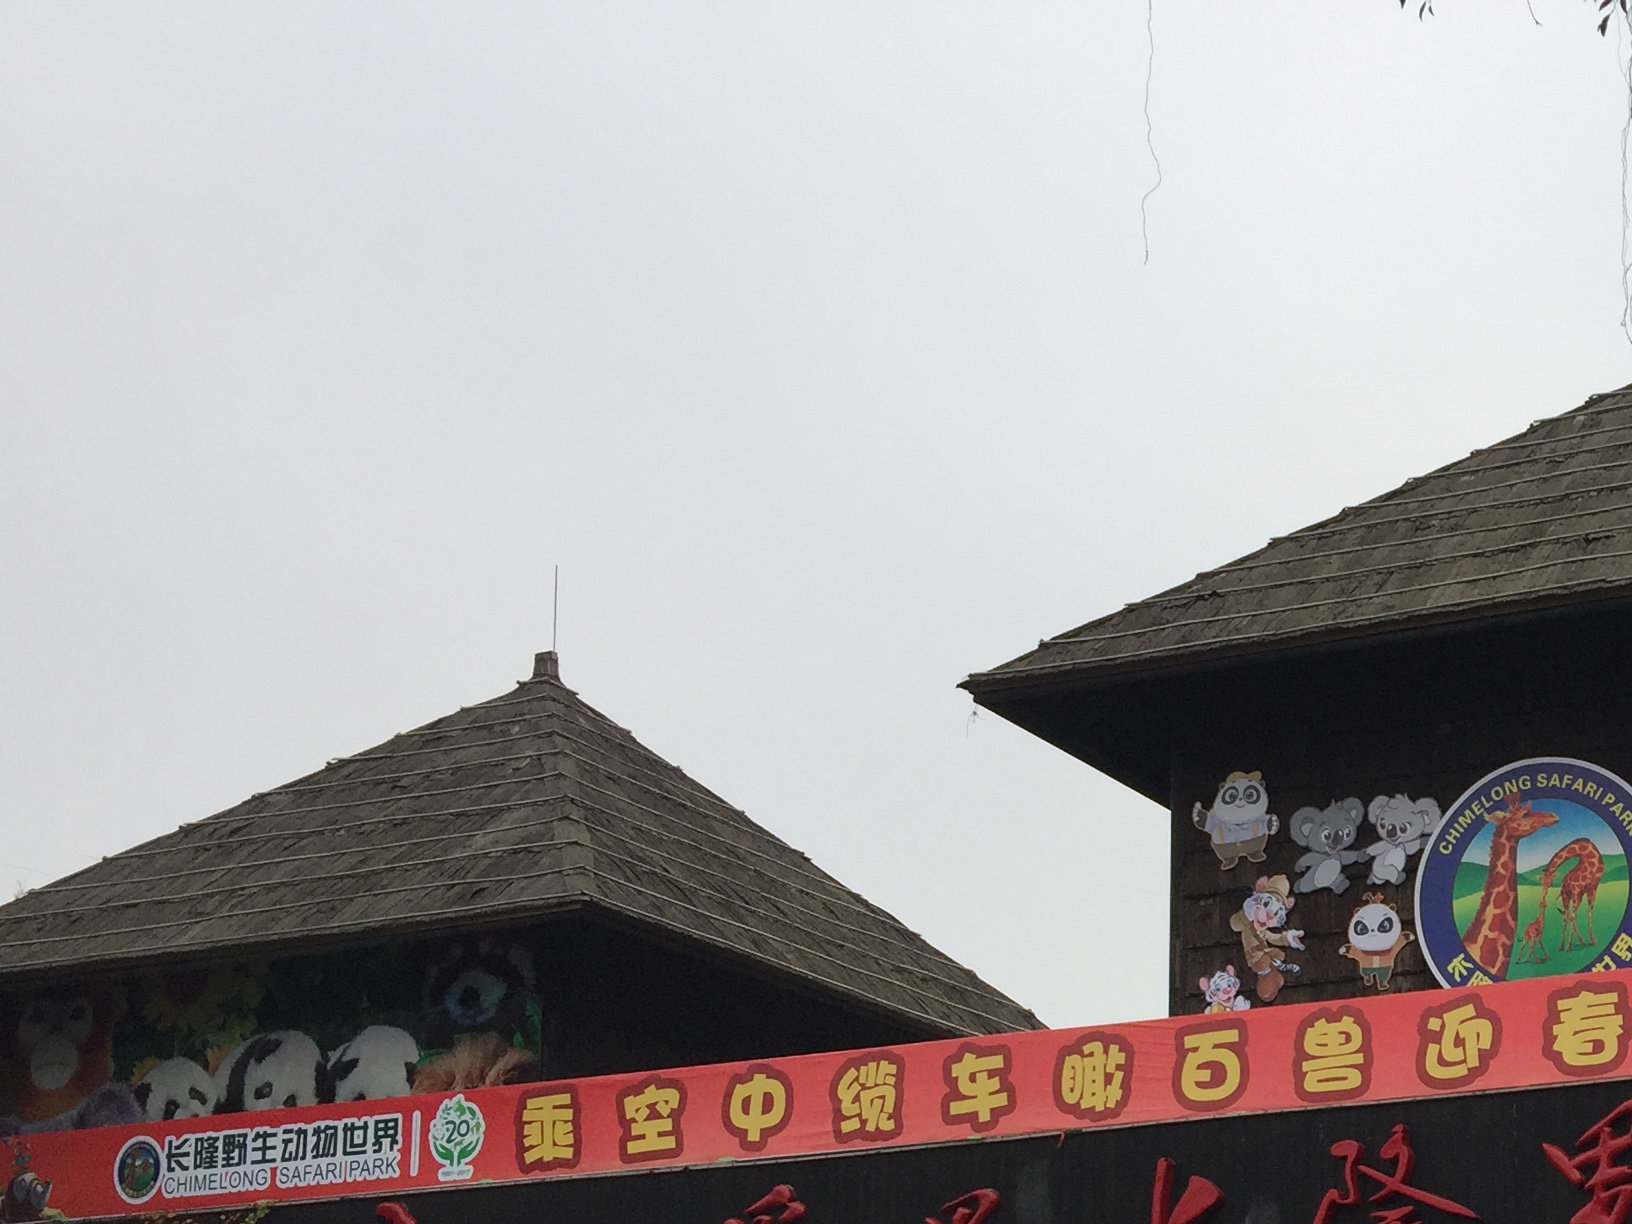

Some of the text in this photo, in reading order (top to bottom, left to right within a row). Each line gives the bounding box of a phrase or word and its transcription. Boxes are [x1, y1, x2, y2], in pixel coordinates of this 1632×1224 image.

[1439, 776, 1532, 854] CHIMELONG
[1537, 773, 1604, 800] SAFARI
[165, 1117, 400, 1173] 长隆野生动物世界
[164, 1168, 268, 1195] CHIMELONG
[279, 1160, 343, 1186] SAFARI
[349, 1156, 398, 1177] PARK
